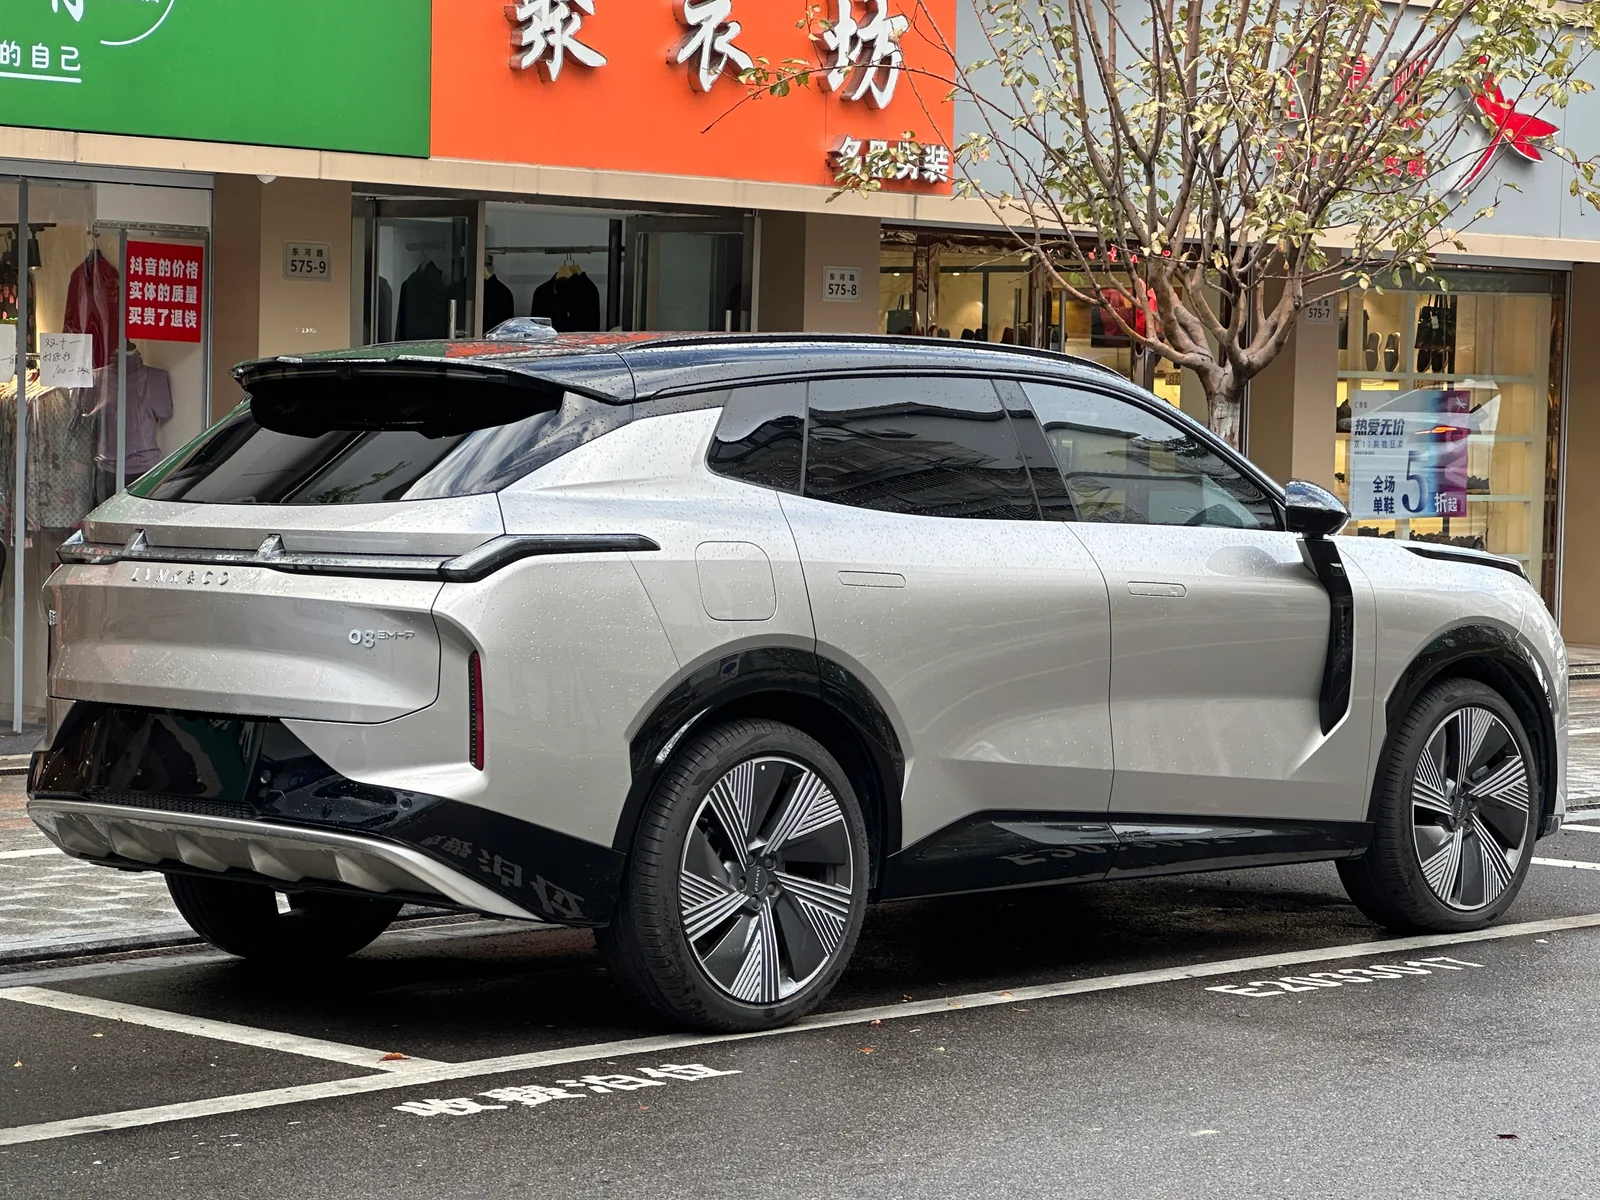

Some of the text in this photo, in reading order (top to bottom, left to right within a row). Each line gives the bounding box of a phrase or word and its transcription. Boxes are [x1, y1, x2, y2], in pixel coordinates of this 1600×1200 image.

[0, 40, 81, 71] 的自己
[129, 255, 199, 280] 抖音的价格
[290, 259, 327, 274] 575-9
[129, 280, 198, 304] 实体的质量
[828, 283, 858, 296] 575-8
[128, 306, 197, 329] 买贵了退钱
[1308, 308, 1331, 319] 575-7
[1354, 418, 1406, 436] 热爱无价
[1373, 475, 1396, 493] 全场
[1402, 450, 1429, 513] 5
[1373, 496, 1396, 515] 单鞋
[1434, 492, 1458, 513] 折起
[348, 629, 416, 649] 08 EM-P
[1204, 956, 1486, 998] E2033017
[392, 1063, 744, 1117] 收费泊位
